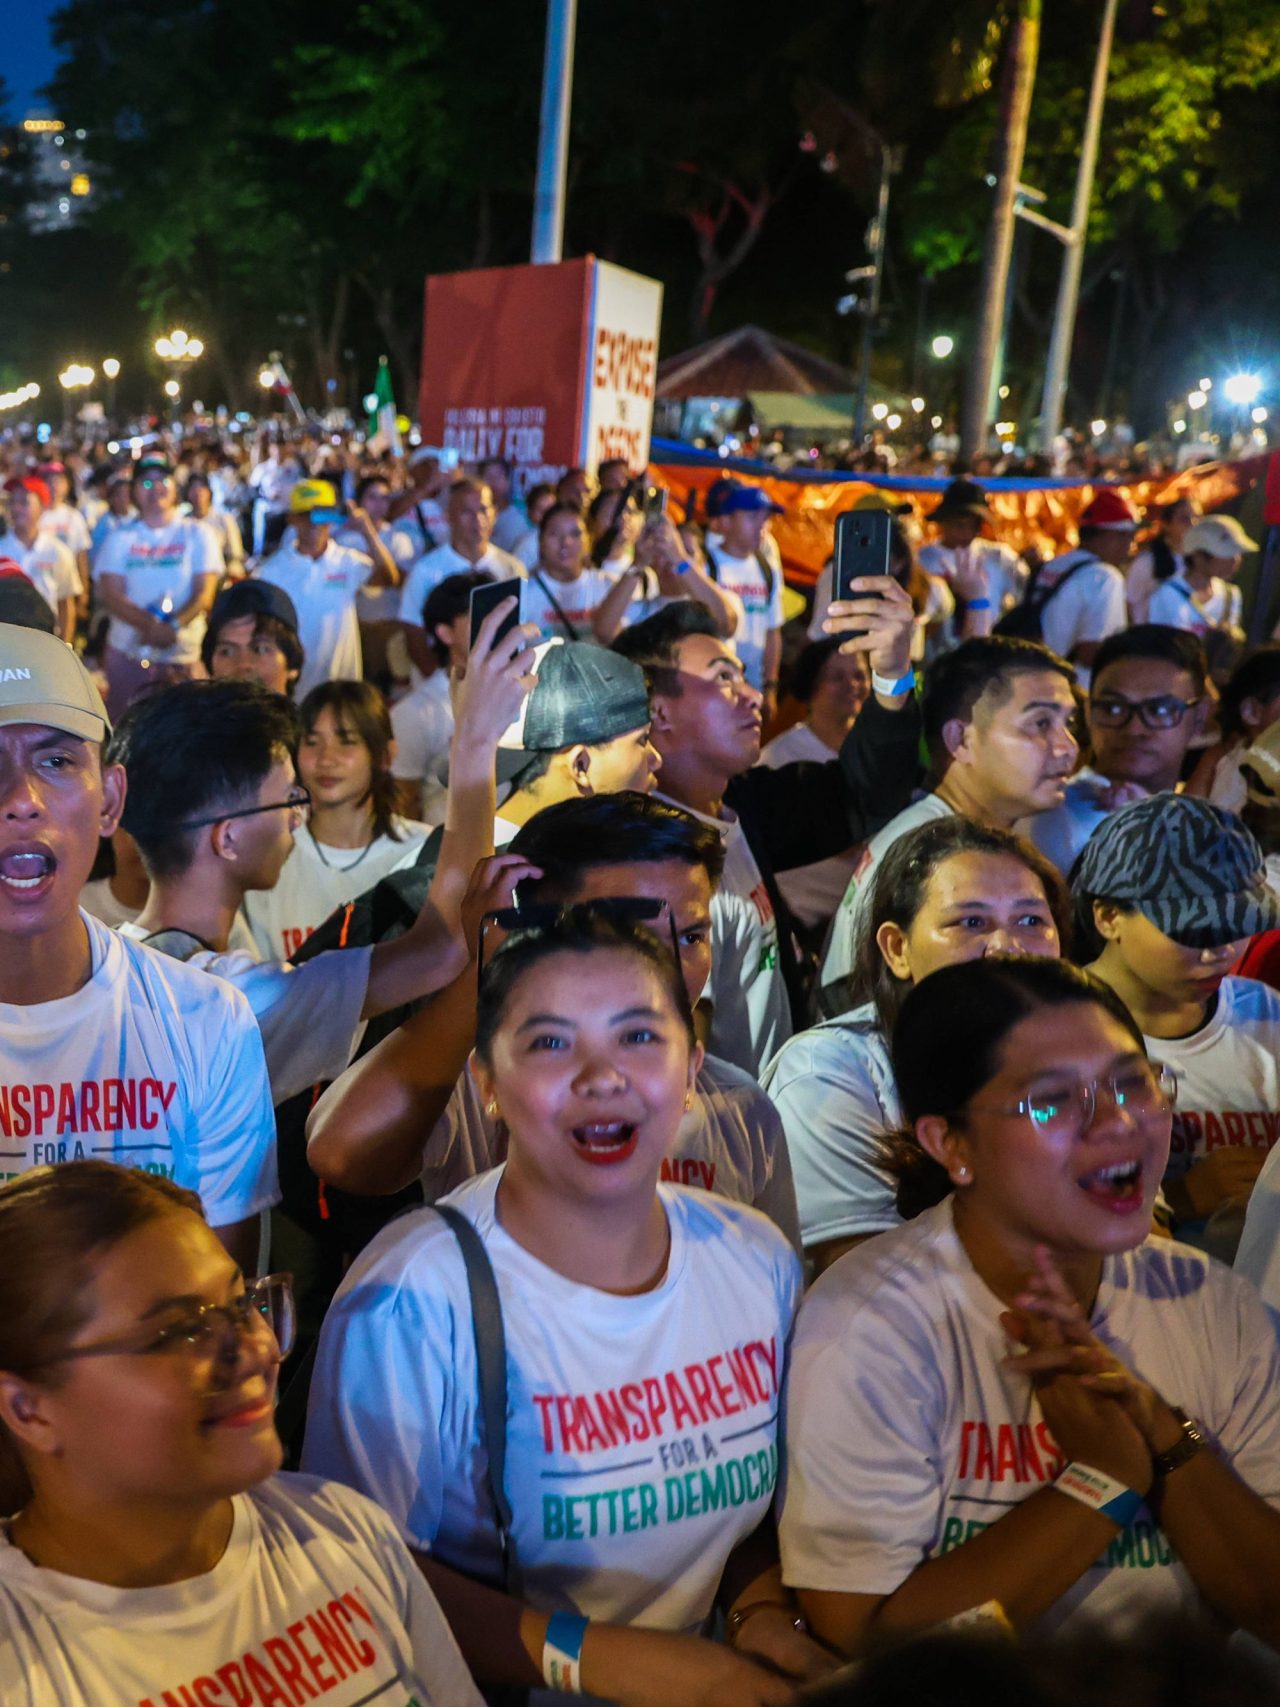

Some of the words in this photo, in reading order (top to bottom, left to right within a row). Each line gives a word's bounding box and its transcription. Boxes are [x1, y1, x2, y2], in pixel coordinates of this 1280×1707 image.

[34, 1142, 66, 1165] FOR
[74, 1140, 86, 1161] A
[532, 1337, 779, 1455] TRANSPARENCY
[659, 1437, 699, 1471] FOR
[703, 1431, 718, 1458] A
[543, 1482, 658, 1540] BETTER
